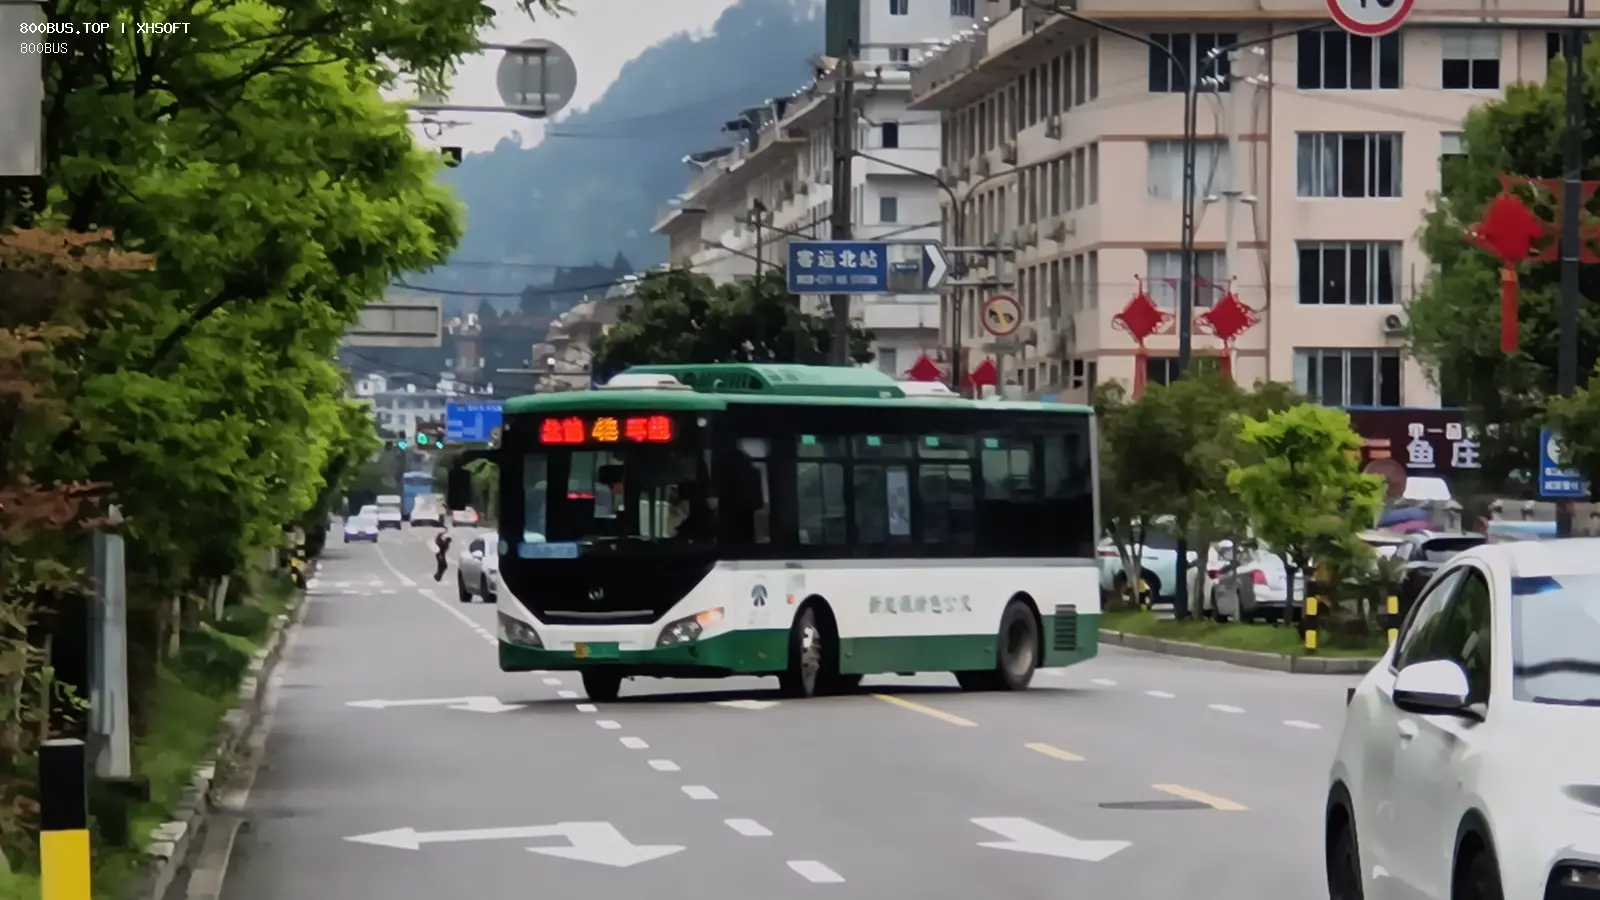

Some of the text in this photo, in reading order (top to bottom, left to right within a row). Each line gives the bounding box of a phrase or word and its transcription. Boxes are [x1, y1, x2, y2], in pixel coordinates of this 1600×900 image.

[796, 250, 879, 269] 客运北站
[1406, 439, 1482, 468] 鱼庄
